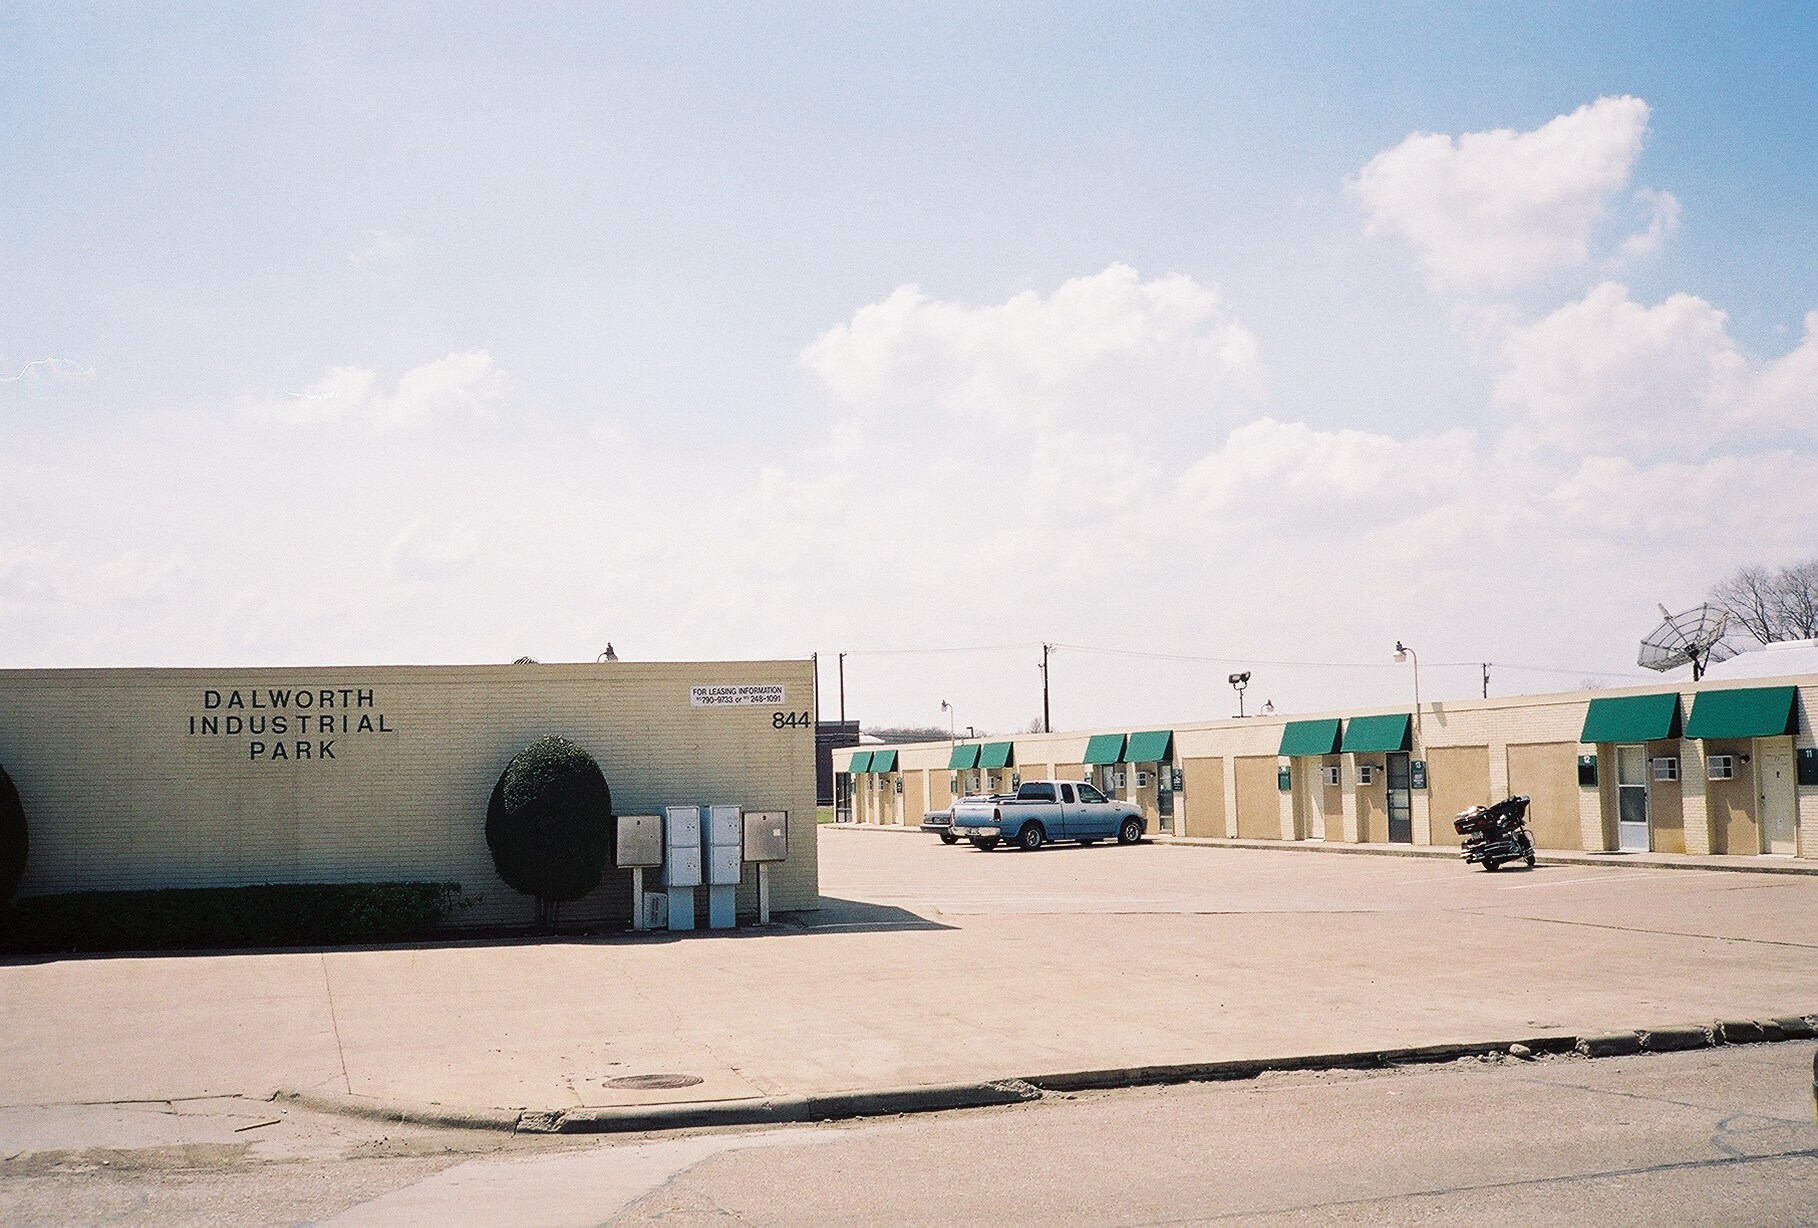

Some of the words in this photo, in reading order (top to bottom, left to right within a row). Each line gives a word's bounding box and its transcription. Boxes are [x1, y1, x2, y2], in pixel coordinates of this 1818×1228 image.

[708, 687, 737, 695] LEASING
[739, 686, 782, 694] INFORMATION
[204, 689, 374, 709] DALWORTH
[702, 696, 733, 704] 790-9733
[751, 695, 781, 703] 248-1091
[189, 714, 393, 735] INDUSTRIAL
[772, 711, 811, 729] 844
[250, 740, 336, 760] PARK
[1805, 749, 1812, 758] 11
[1583, 755, 1591, 763] 12
